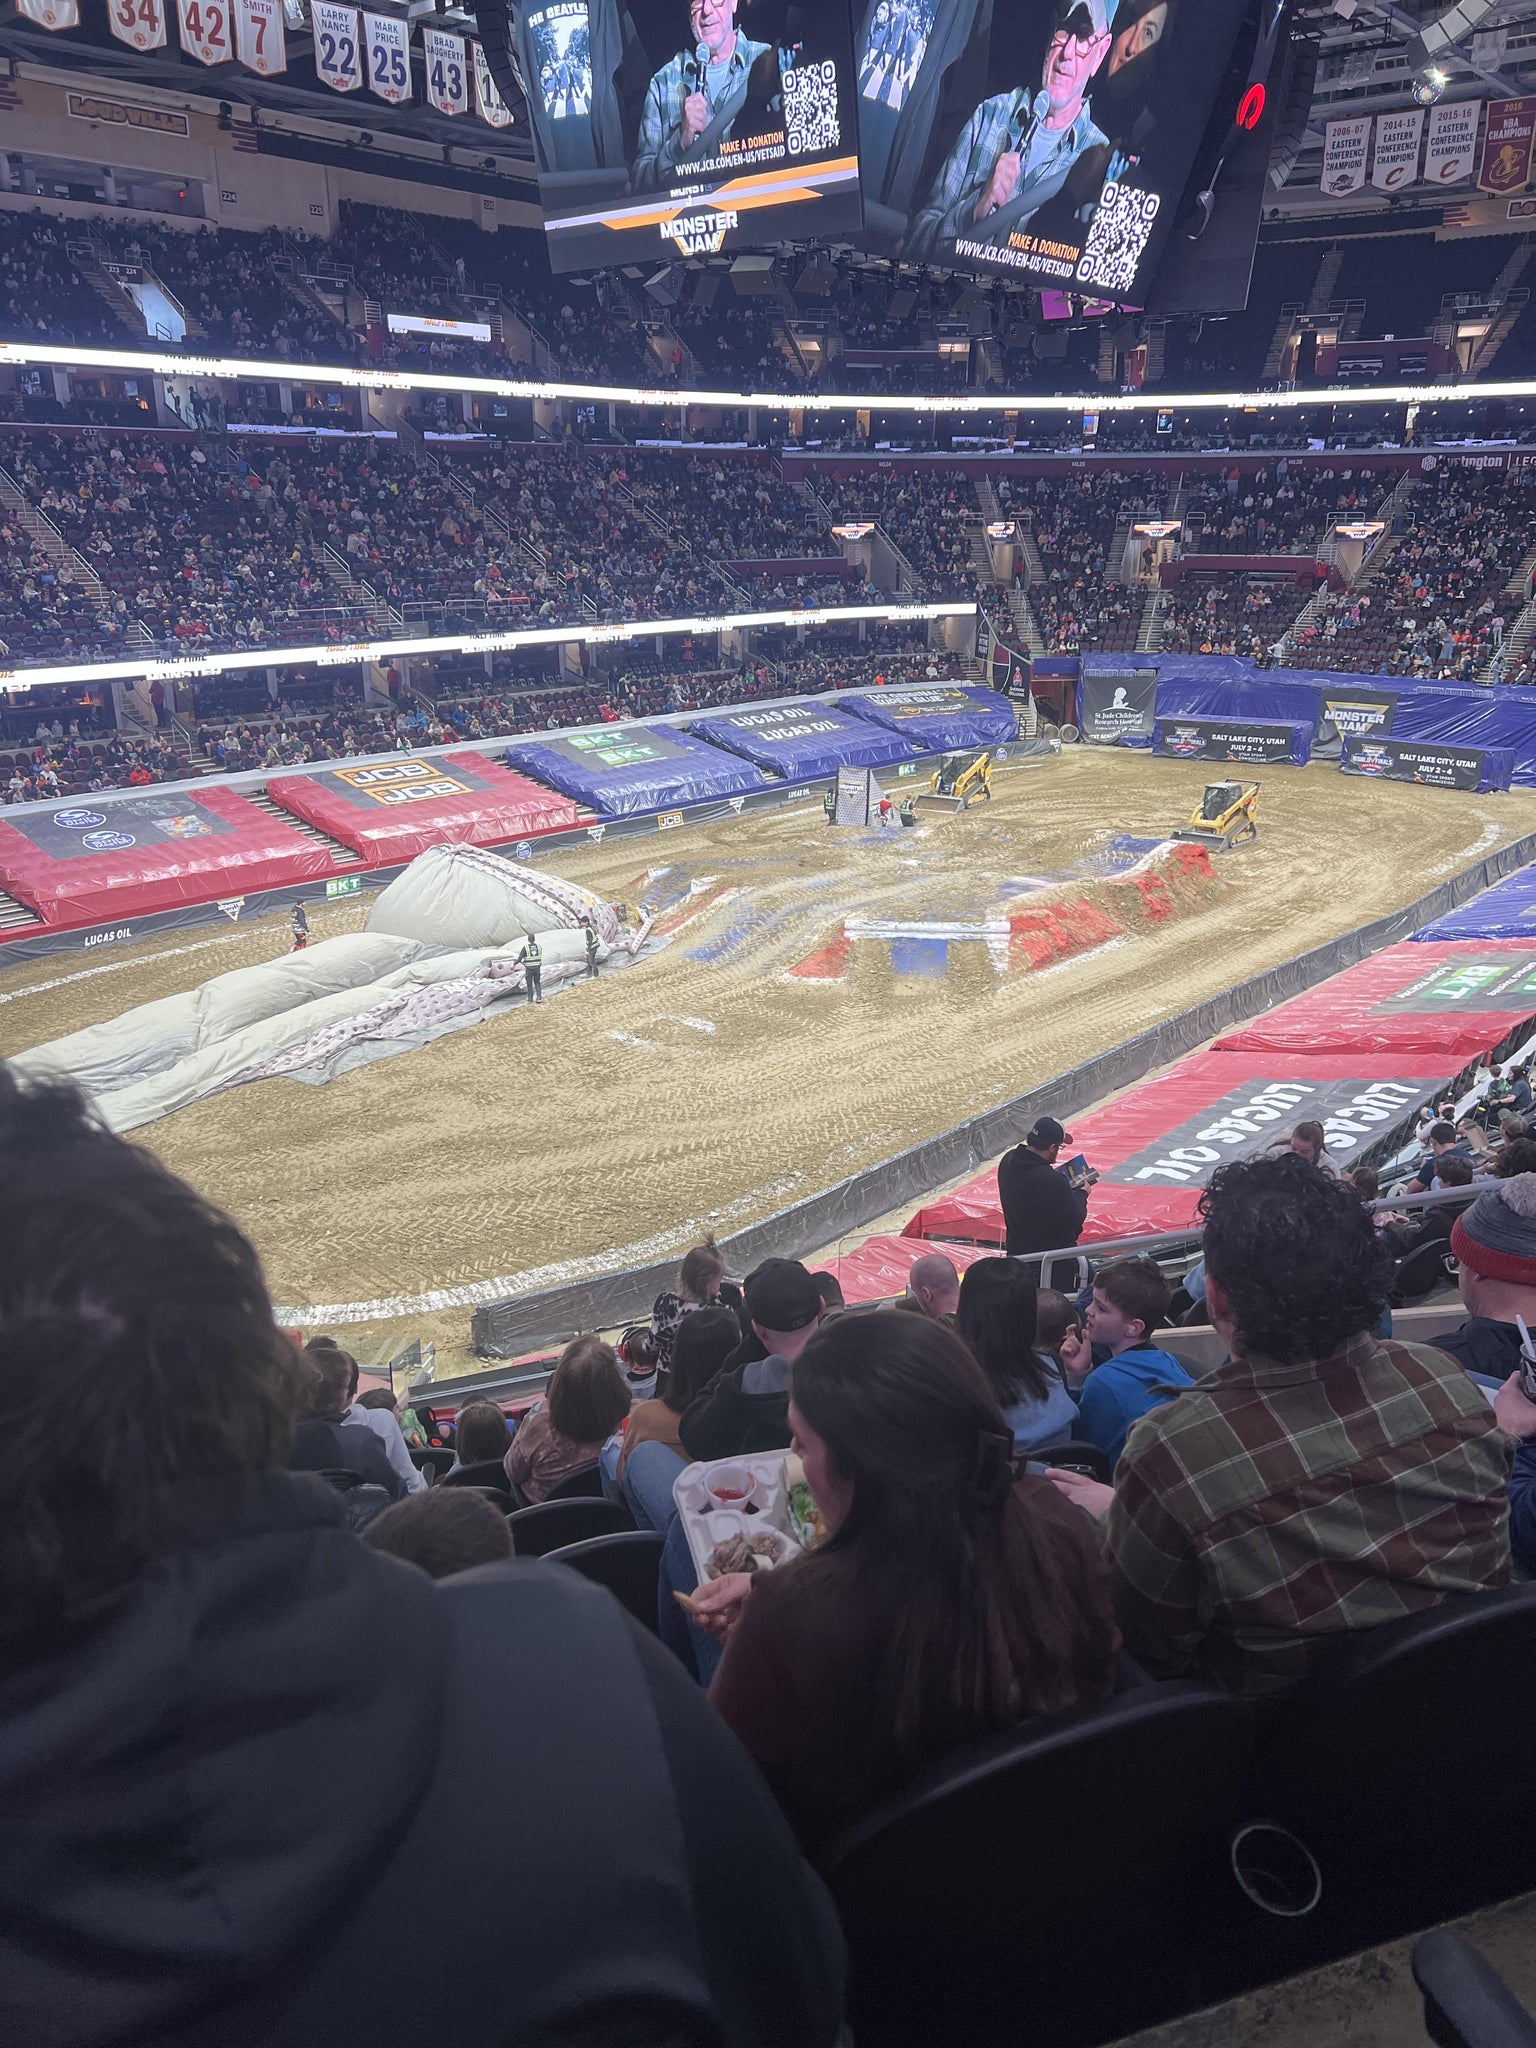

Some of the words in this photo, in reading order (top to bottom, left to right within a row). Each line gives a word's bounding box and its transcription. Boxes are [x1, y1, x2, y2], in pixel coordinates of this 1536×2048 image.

[243, 0, 272, 15] SMITH
[117, 0, 159, 33] 34
[321, 8, 349, 22] LARRY
[528, 11, 545, 28] HE
[546, 2, 588, 19] BEATLE
[185, 1, 226, 48] 42
[321, 18, 351, 34] NANCE
[375, 20, 399, 34] MARK
[251, 15, 267, 55] 7
[375, 32, 400, 46] PRICE
[434, 36, 455, 49] BRAD
[320, 33, 357, 76] 22
[372, 45, 408, 87] 25
[431, 60, 462, 100] 43
[1503, 101, 1523, 112] 2016
[1437, 108, 1472, 122] 2015-16
[1383, 117, 1416, 131] 2014-15
[1437, 122, 1469, 134] EASTERN
[1503, 117, 1519, 128] NBA
[1332, 125, 1364, 137] 2006-07
[1383, 131, 1413, 143] EASTERN
[1488, 126, 1532, 141] CHAMPIONS
[719, 140, 741, 154] MAKE
[741, 138, 748, 150] A
[748, 131, 785, 149] DONATION
[1332, 138, 1361, 149] EASTERN
[1430, 133, 1474, 147] CONFERENCE
[1325, 147, 1366, 161] CONFERENCE
[1376, 141, 1418, 154] CONFERENCE
[1431, 144, 1470, 157] CHAMPIONS
[1325, 159, 1363, 171] CHAMPIONS
[1376, 152, 1415, 165] CHAMPIONS
[222, 191, 236, 202] 224
[310, 205, 323, 216] 225
[660, 211, 739, 239] MONSTER
[678, 231, 720, 253] JAM
[1007, 232, 1033, 249] MAKE
[1030, 237, 1039, 252] A
[1038, 239, 1080, 261] DONATION
[730, 710, 785, 727] LUCAS
[782, 707, 813, 718] OIL
[1102, 712, 1115, 720] Jude
[1324, 710, 1386, 724] MONSTER
[758, 725, 813, 741] LUCAS
[810, 720, 841, 732] OIL
[1339, 721, 1368, 732] JAM
[570, 731, 626, 748] BKT
[1211, 733, 1228, 741] SALT
[1247, 736, 1266, 744] CITY,
[1266, 737, 1286, 745] UTAH
[1230, 744, 1246, 752] JULY
[600, 746, 656, 765] BKT
[1399, 753, 1417, 761] SALT
[1417, 755, 1437, 763] LAKE
[1437, 757, 1455, 766] CITY,
[1455, 760, 1477, 768] UTAH
[353, 763, 433, 783] JCB
[899, 764, 916, 775] BKT
[382, 781, 463, 803] JCB
[660, 815, 682, 827] JCB
[326, 878, 360, 894] BKT
[84, 931, 115, 947] LUCAS
[116, 927, 132, 940] OIL
[1196, 1082, 1316, 1145] LUCAS
[1323, 1082, 1421, 1149] LUCAS
[1134, 1146, 1222, 1182] OIL
